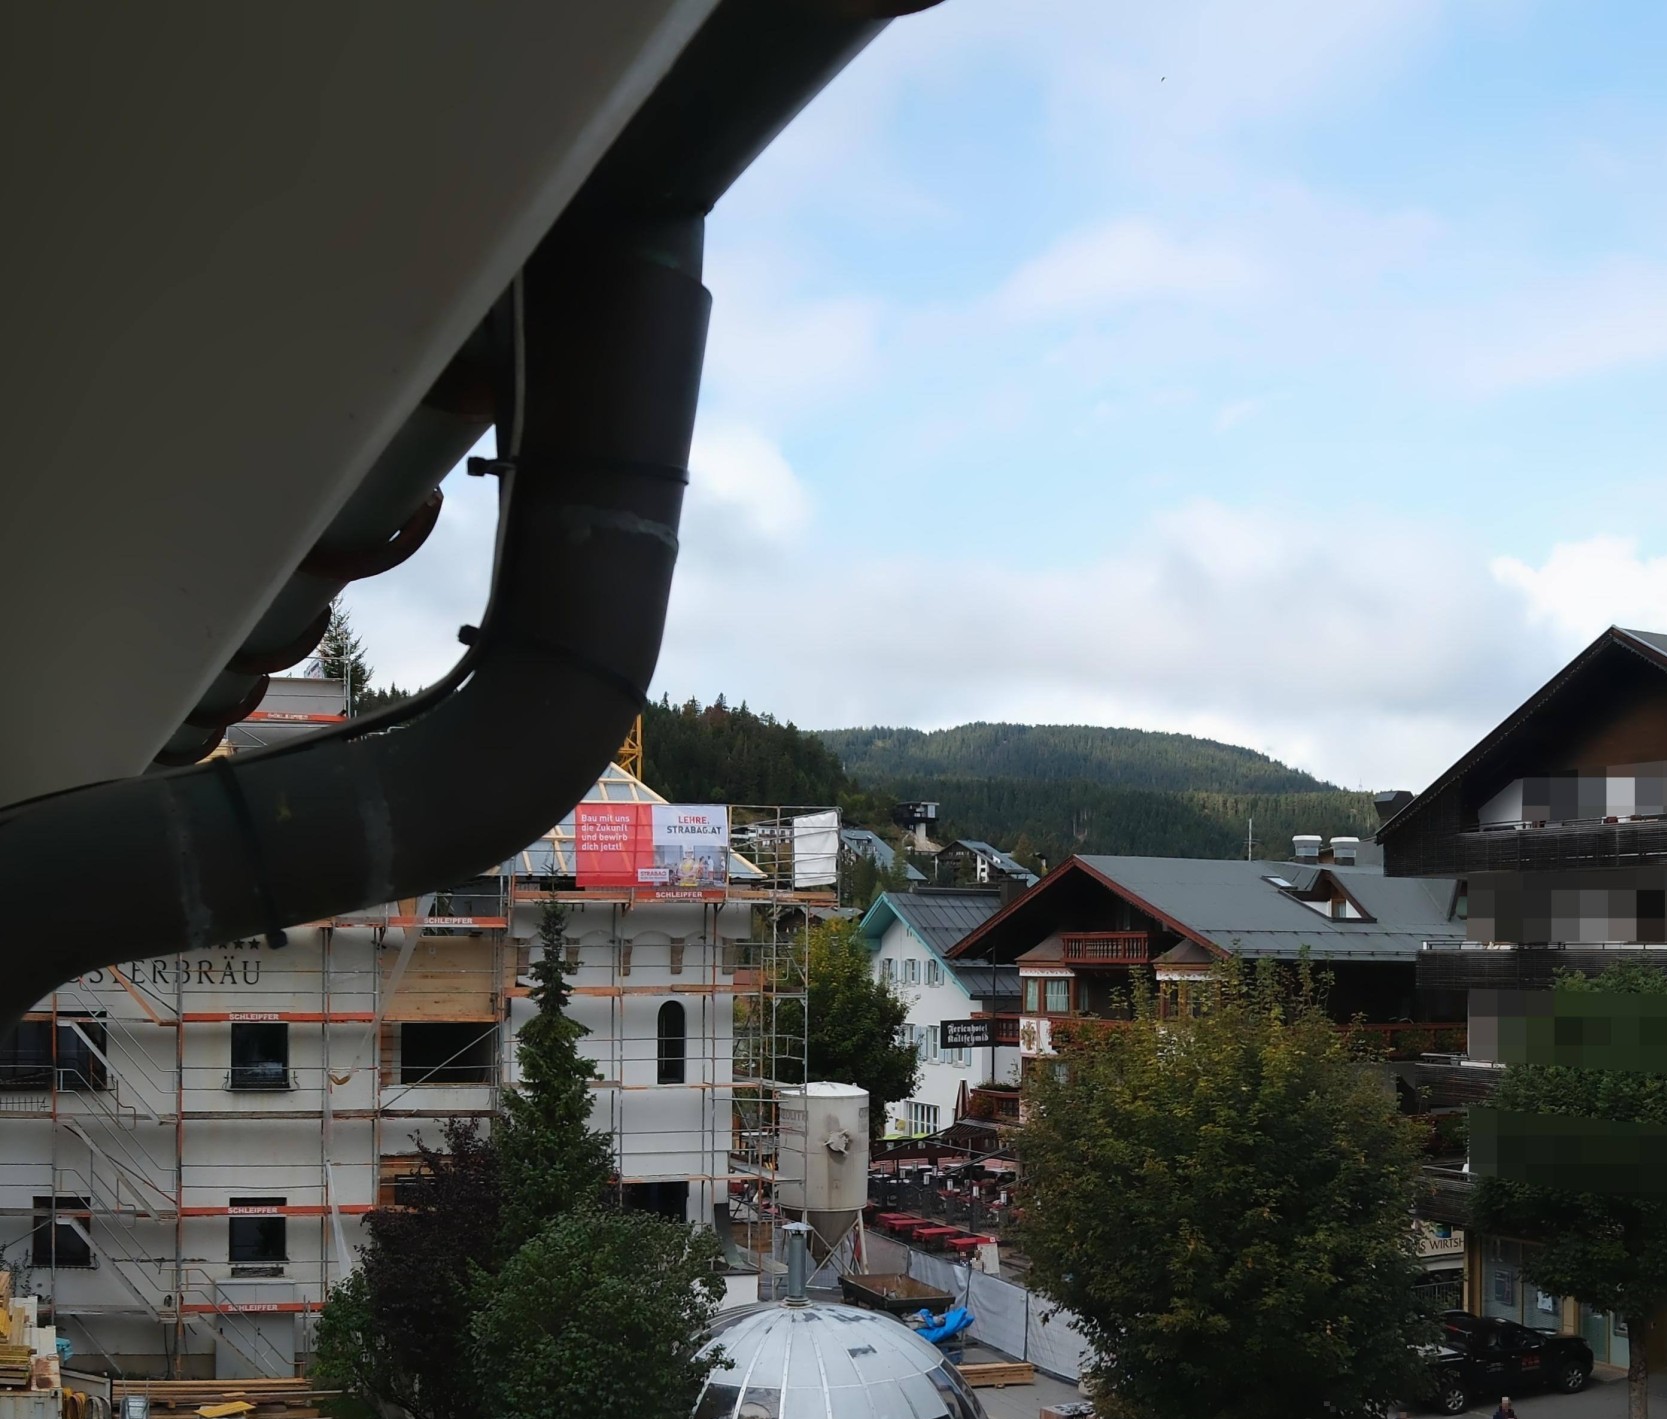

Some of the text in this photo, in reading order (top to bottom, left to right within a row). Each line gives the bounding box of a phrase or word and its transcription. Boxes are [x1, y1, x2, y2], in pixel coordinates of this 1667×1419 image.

[581, 814, 597, 823] Bau
[600, 814, 613, 823] mit
[678, 816, 710, 825] LEHRE.
[582, 823, 628, 832] die Zukunft
[667, 825, 721, 835] STRABAG.AT
[582, 833, 628, 841] und bewirb
[582, 842, 598, 850] dich
[655, 890, 702, 899] SCHLEIPFER
[424, 916, 473, 925] SCHLEIPFER
